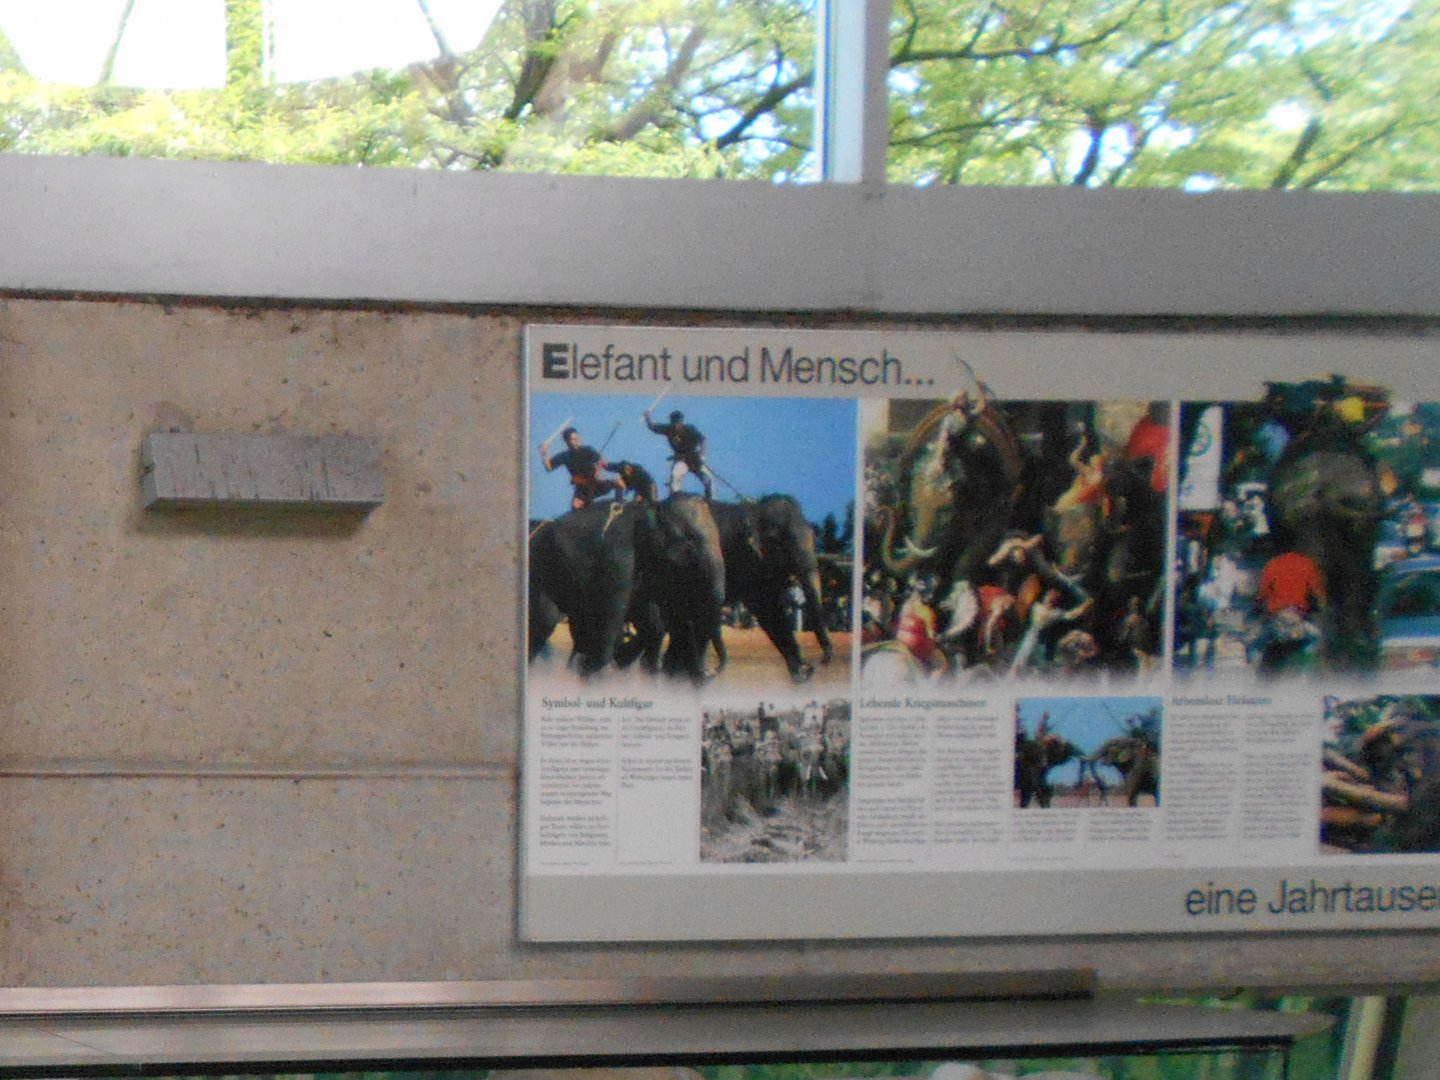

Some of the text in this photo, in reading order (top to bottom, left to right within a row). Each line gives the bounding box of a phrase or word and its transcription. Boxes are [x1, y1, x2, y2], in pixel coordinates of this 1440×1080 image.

[542, 342, 936, 386] Elefant und Mensch...
[541, 697, 584, 710] Symbol-
[586, 697, 607, 709] und
[1185, 879, 1440, 915] eine Jahrtause
